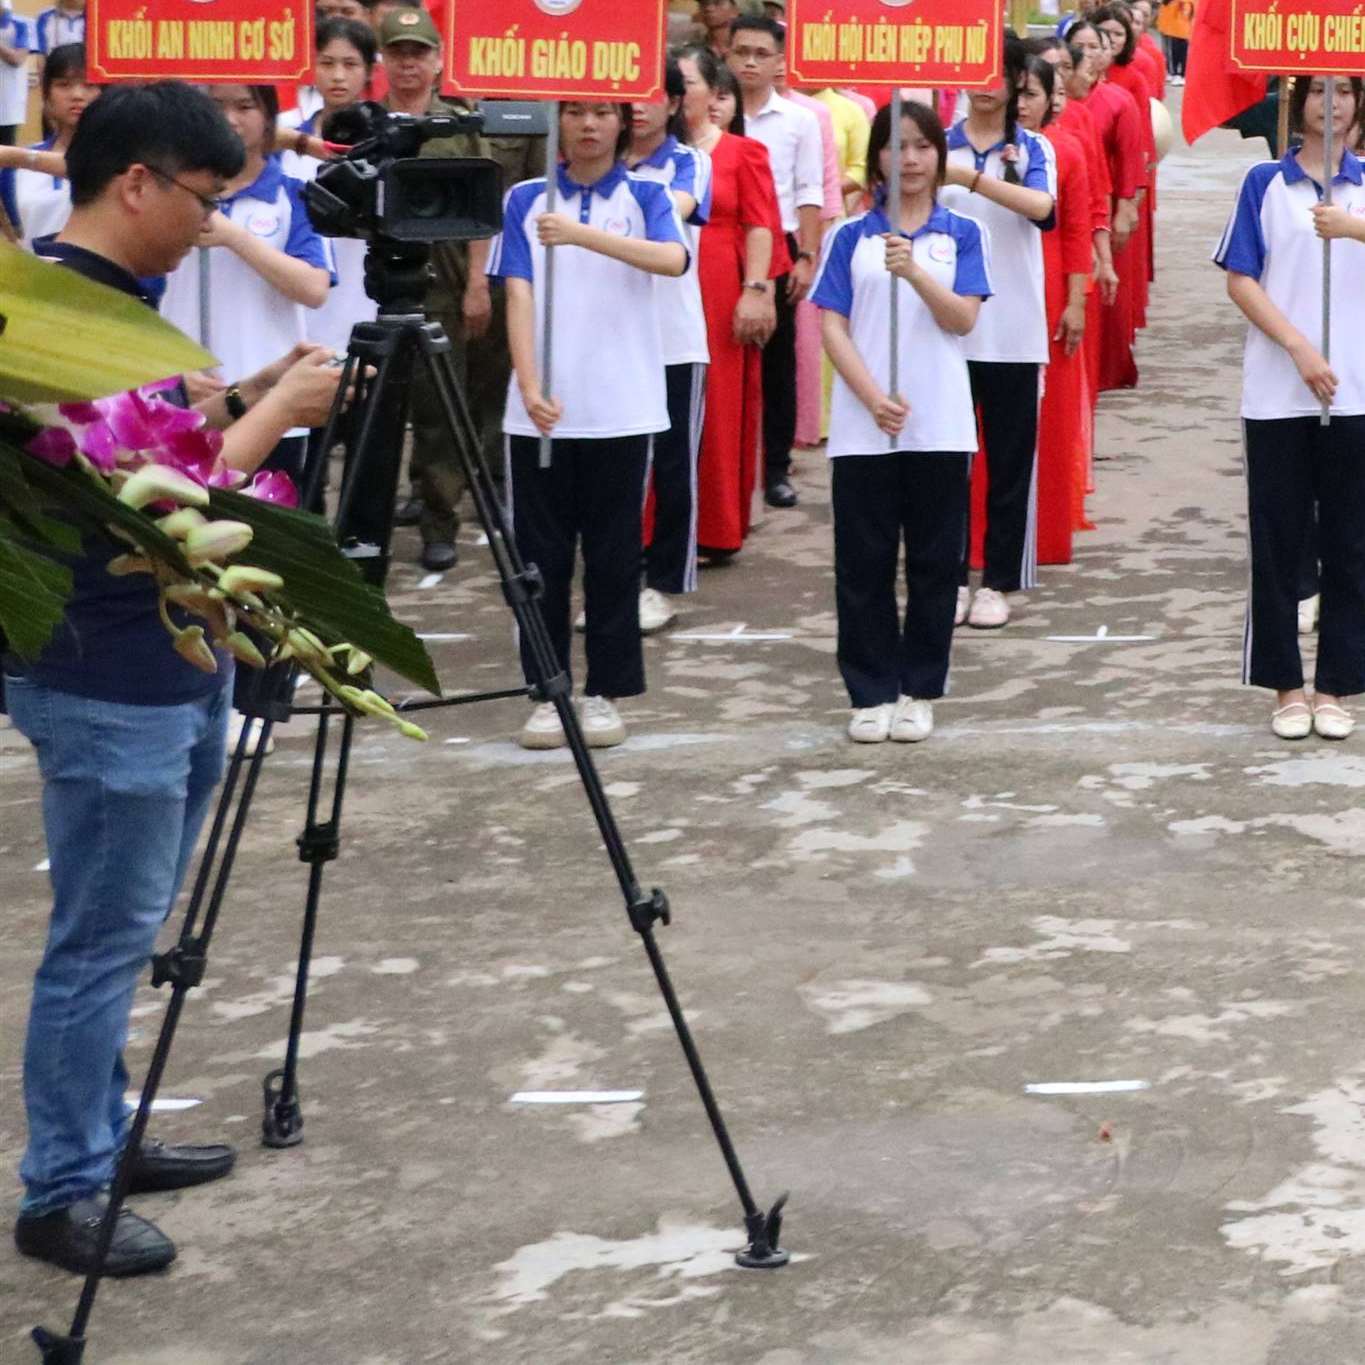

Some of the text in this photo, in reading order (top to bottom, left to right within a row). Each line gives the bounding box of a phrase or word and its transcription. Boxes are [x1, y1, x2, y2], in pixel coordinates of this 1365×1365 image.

[109, 6, 295, 60] KHỐI AN NINH CƠ SỞ
[470, 24, 640, 90] KHỐI GIÁO DỤC
[803, 10, 988, 72] KHỐI HỘI LIÊN HIỆP PHỤ NỮ
[1244, 0, 1282, 50] KHỐI
[1287, 11, 1320, 59] CỰU
